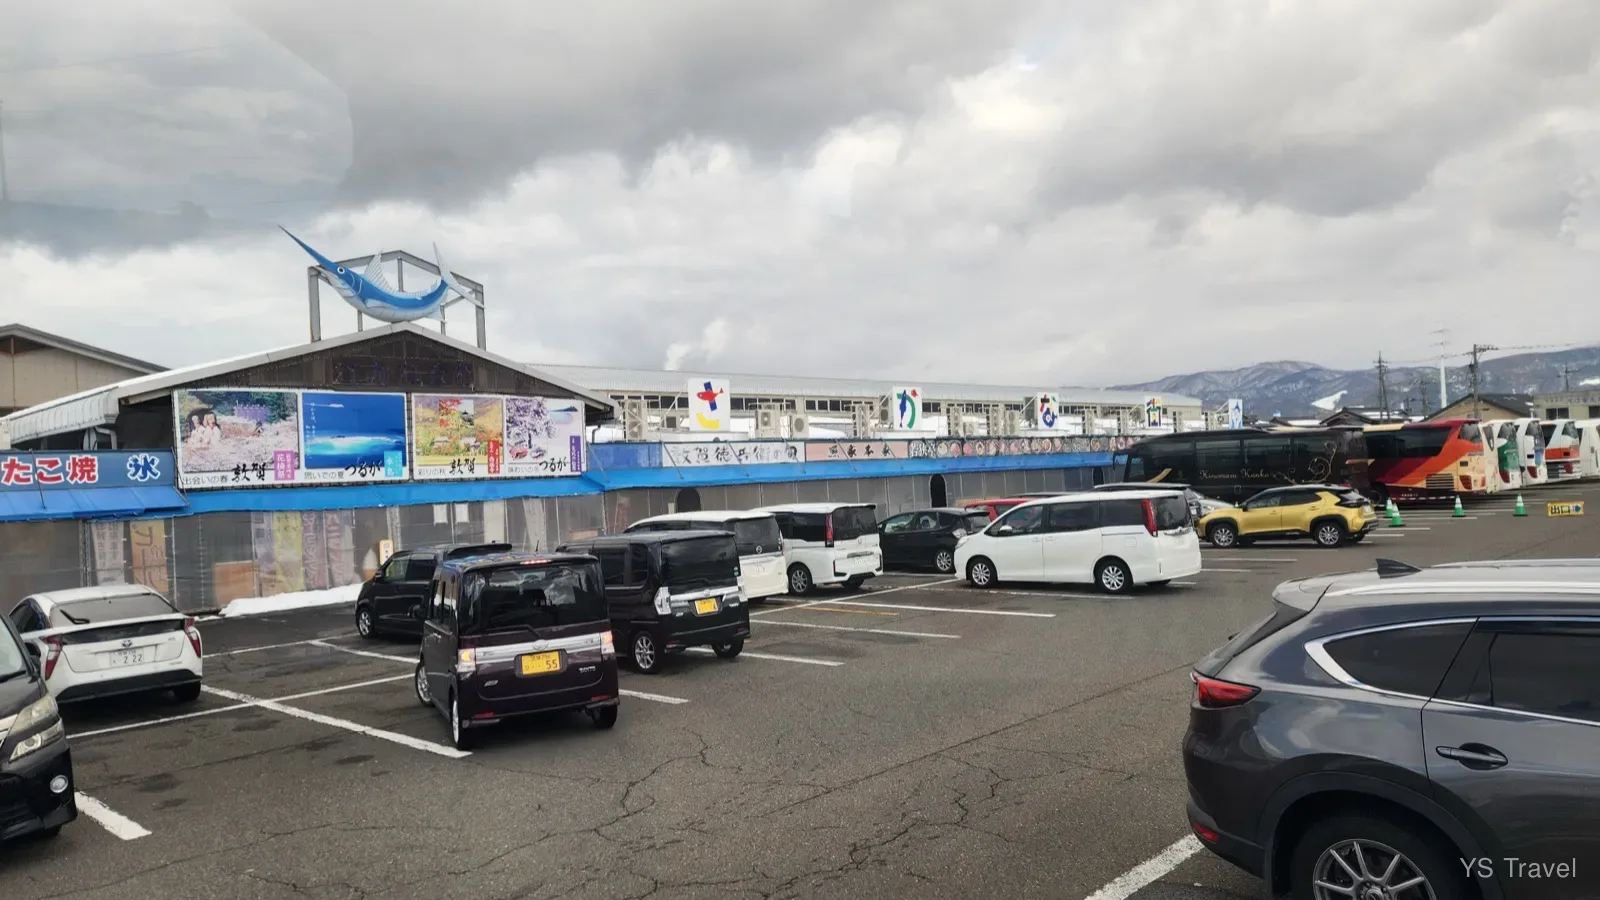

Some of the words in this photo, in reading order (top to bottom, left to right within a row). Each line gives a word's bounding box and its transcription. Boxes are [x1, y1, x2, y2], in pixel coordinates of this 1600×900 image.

[1, 455, 98, 485] たこ焼
[127, 453, 161, 481] 氷
[231, 462, 266, 483] 敦賀
[345, 460, 382, 478] つるが
[449, 457, 475, 475] 敦賀
[539, 456, 566, 472] つるが
[1551, 505, 1571, 515] 出口
[546, 659, 558, 670] 55
